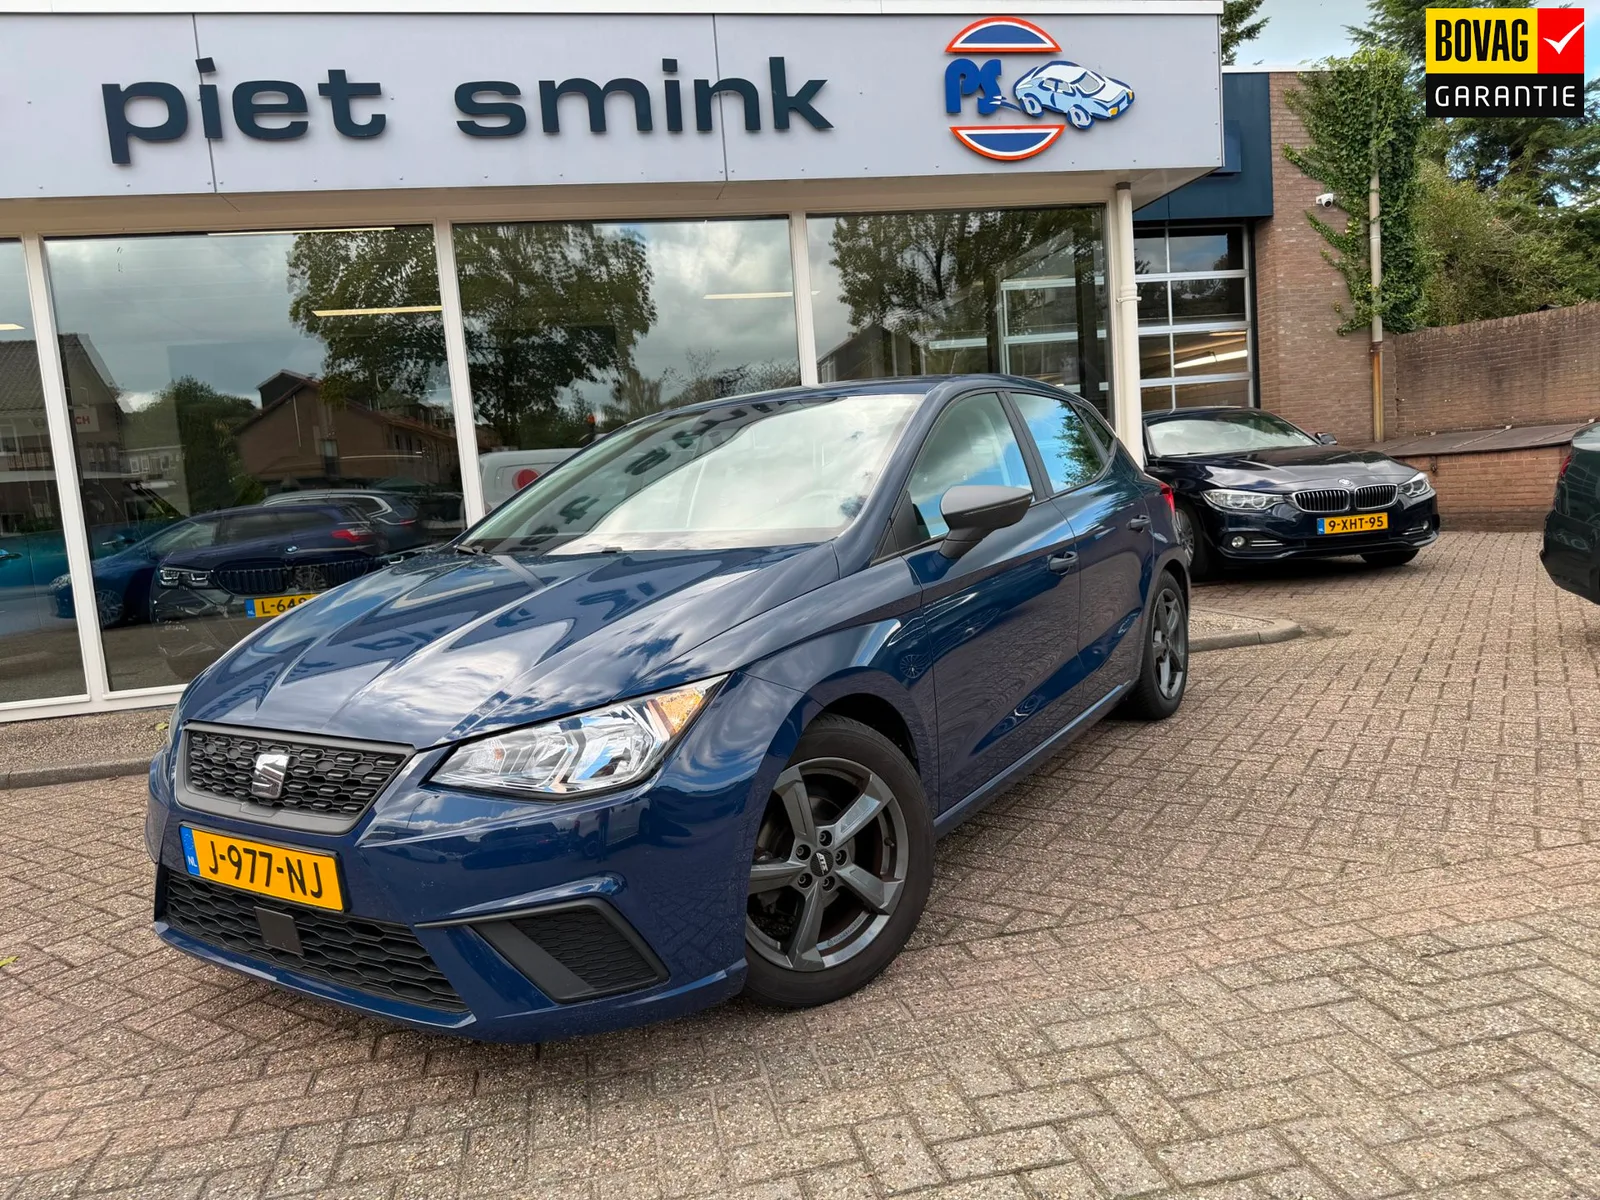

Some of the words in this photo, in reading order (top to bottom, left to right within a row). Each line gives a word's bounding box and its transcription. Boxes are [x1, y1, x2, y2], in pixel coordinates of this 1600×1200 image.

[101, 56, 387, 165] piet
[454, 56, 834, 137] smink
[75, 415, 90, 425] CH
[1328, 516, 1384, 532] 9-XHT-95
[187, 855, 198, 868] NL
[209, 840, 323, 899] J-977-NJ
